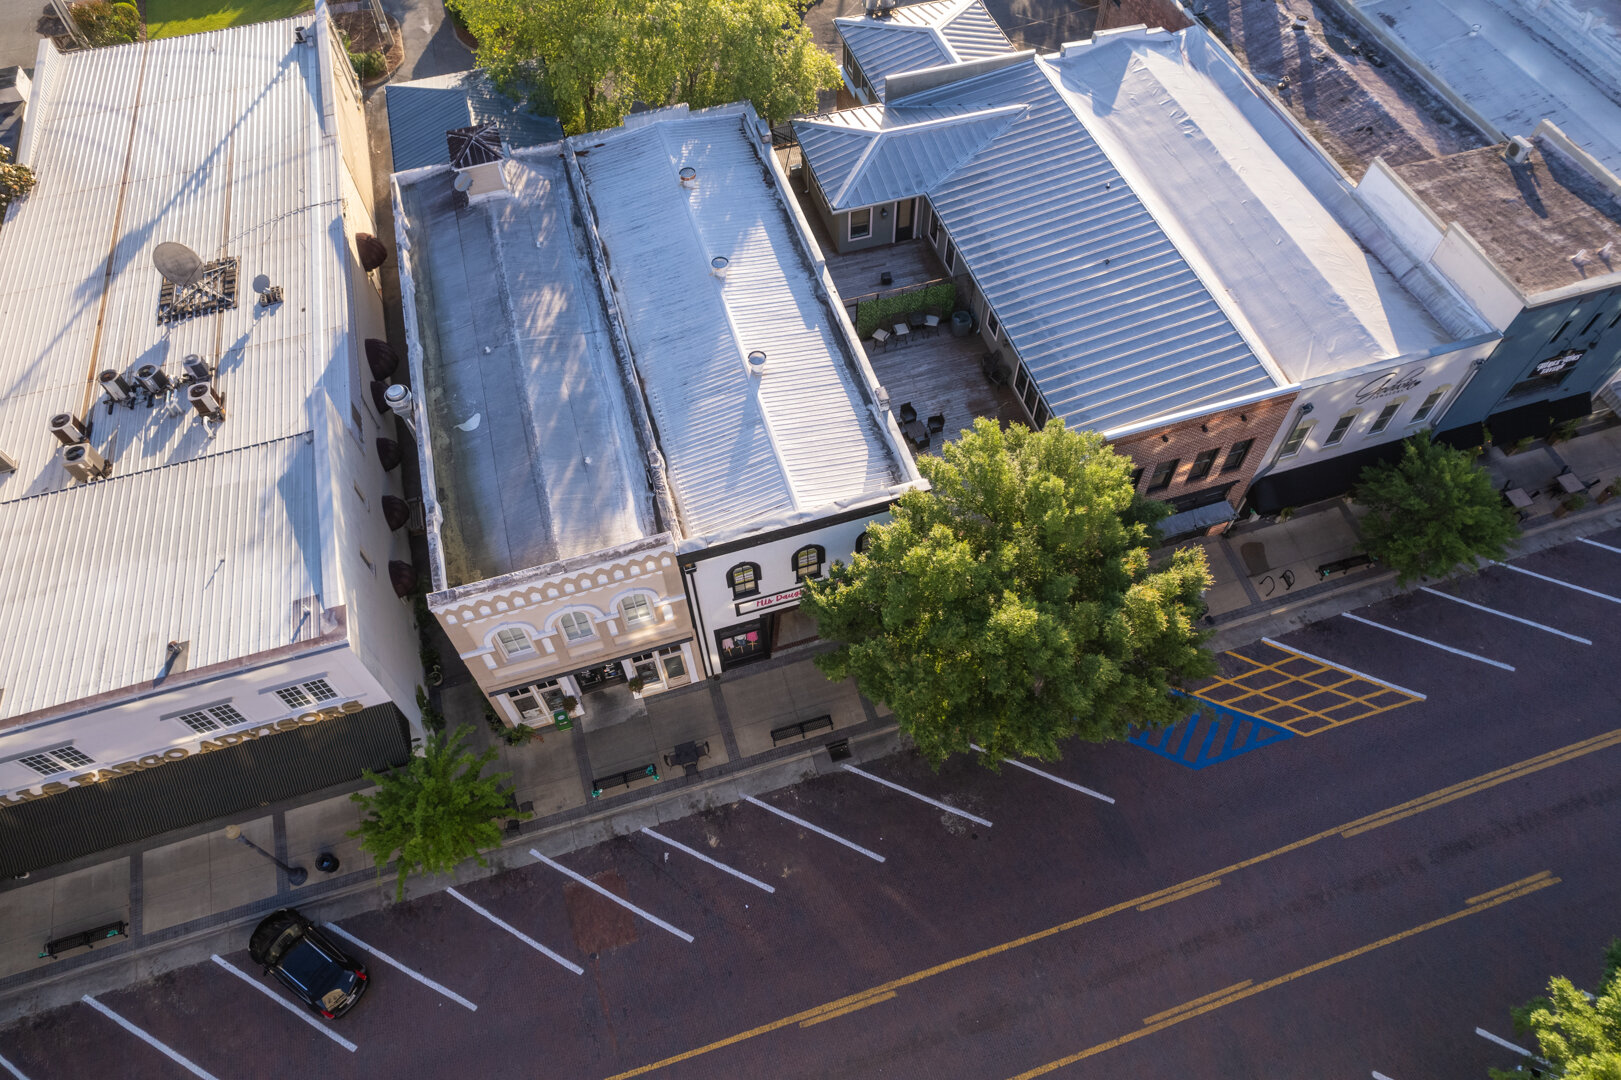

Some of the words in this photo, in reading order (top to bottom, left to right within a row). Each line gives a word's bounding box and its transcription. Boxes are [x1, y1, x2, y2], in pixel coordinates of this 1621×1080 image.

[0, 781, 69, 809] LLS
[69, 747, 190, 787] FARGO
[198, 700, 364, 754] ADVISORS
